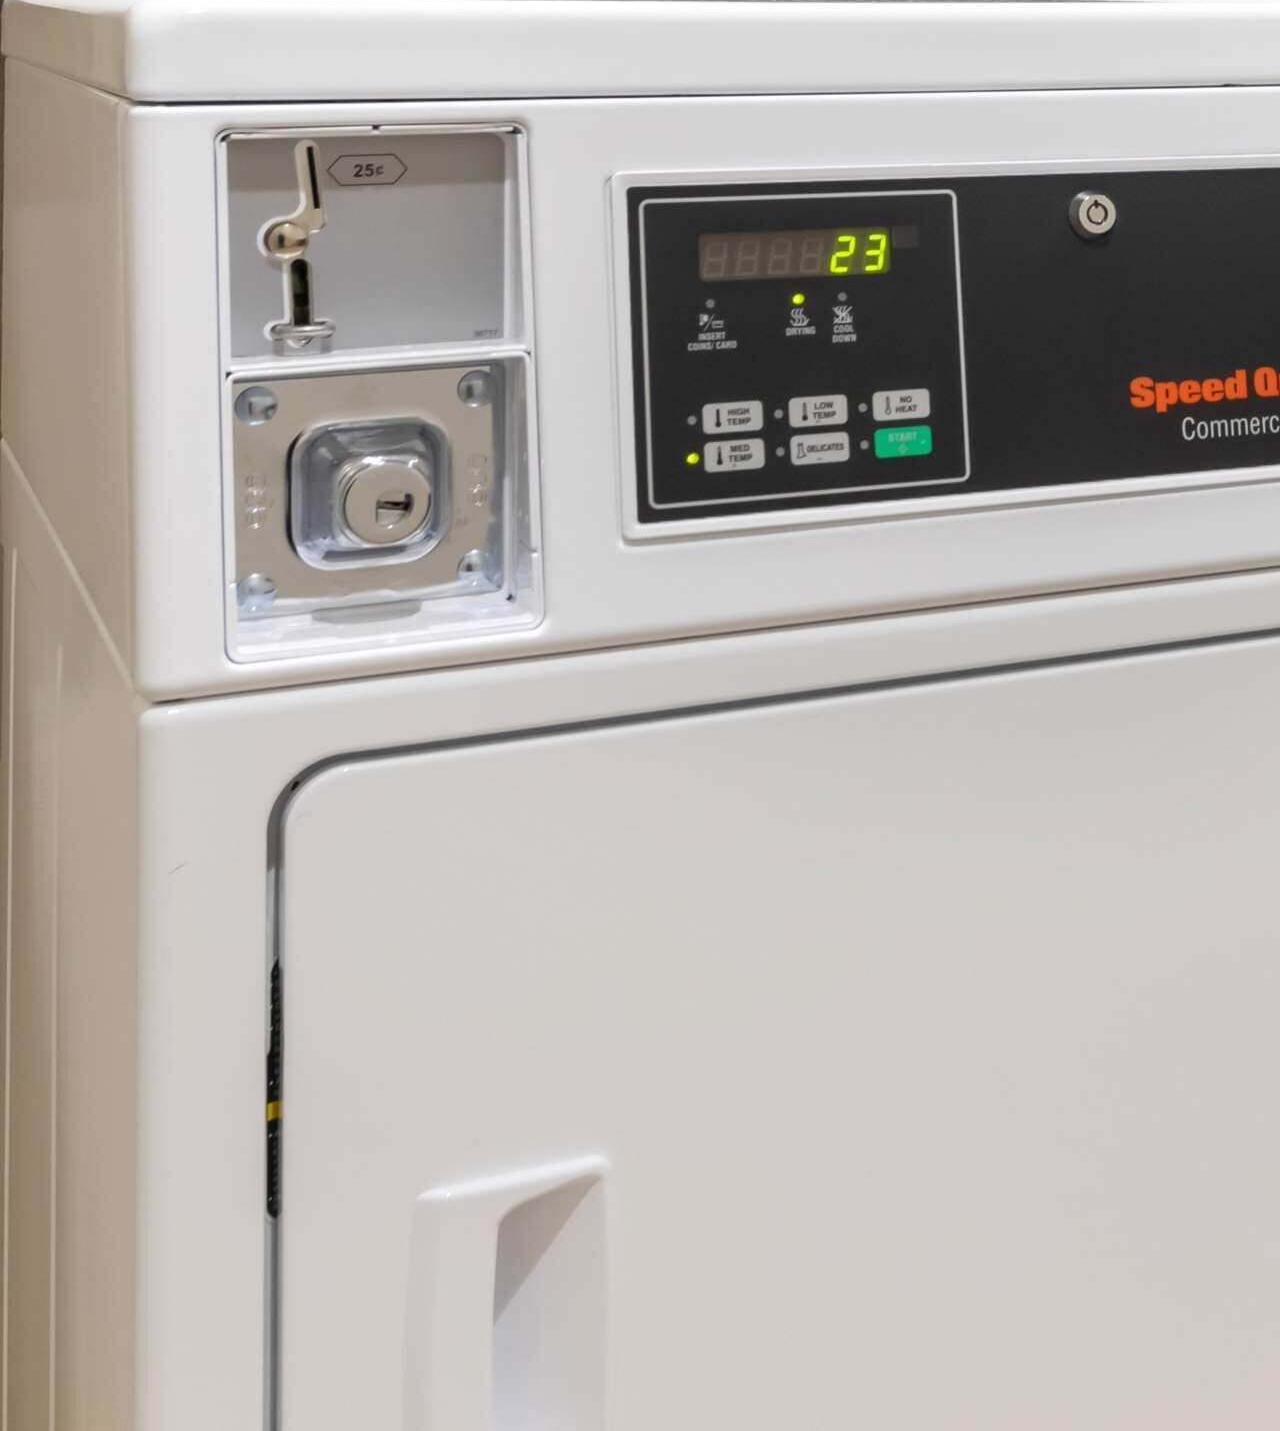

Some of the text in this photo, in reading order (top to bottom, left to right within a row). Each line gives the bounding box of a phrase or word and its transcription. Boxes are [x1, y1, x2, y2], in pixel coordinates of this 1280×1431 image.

[830, 234, 887, 273] 23
[785, 326, 817, 337] DRYING
[833, 324, 854, 334] COOL
[698, 331, 726, 341] INSERT
[832, 334, 857, 343] DOWN
[716, 340, 738, 350] CARD
[1129, 369, 1248, 413] Speed
[814, 401, 834, 410] LOW
[895, 404, 918, 413] HEAT
[727, 408, 750, 417] HIGH
[812, 411, 837, 420] TEMP
[727, 417, 752, 426] TEMP
[729, 443, 750, 452] MED
[806, 442, 845, 453] DELICATES
[728, 453, 753, 463] TEMP
